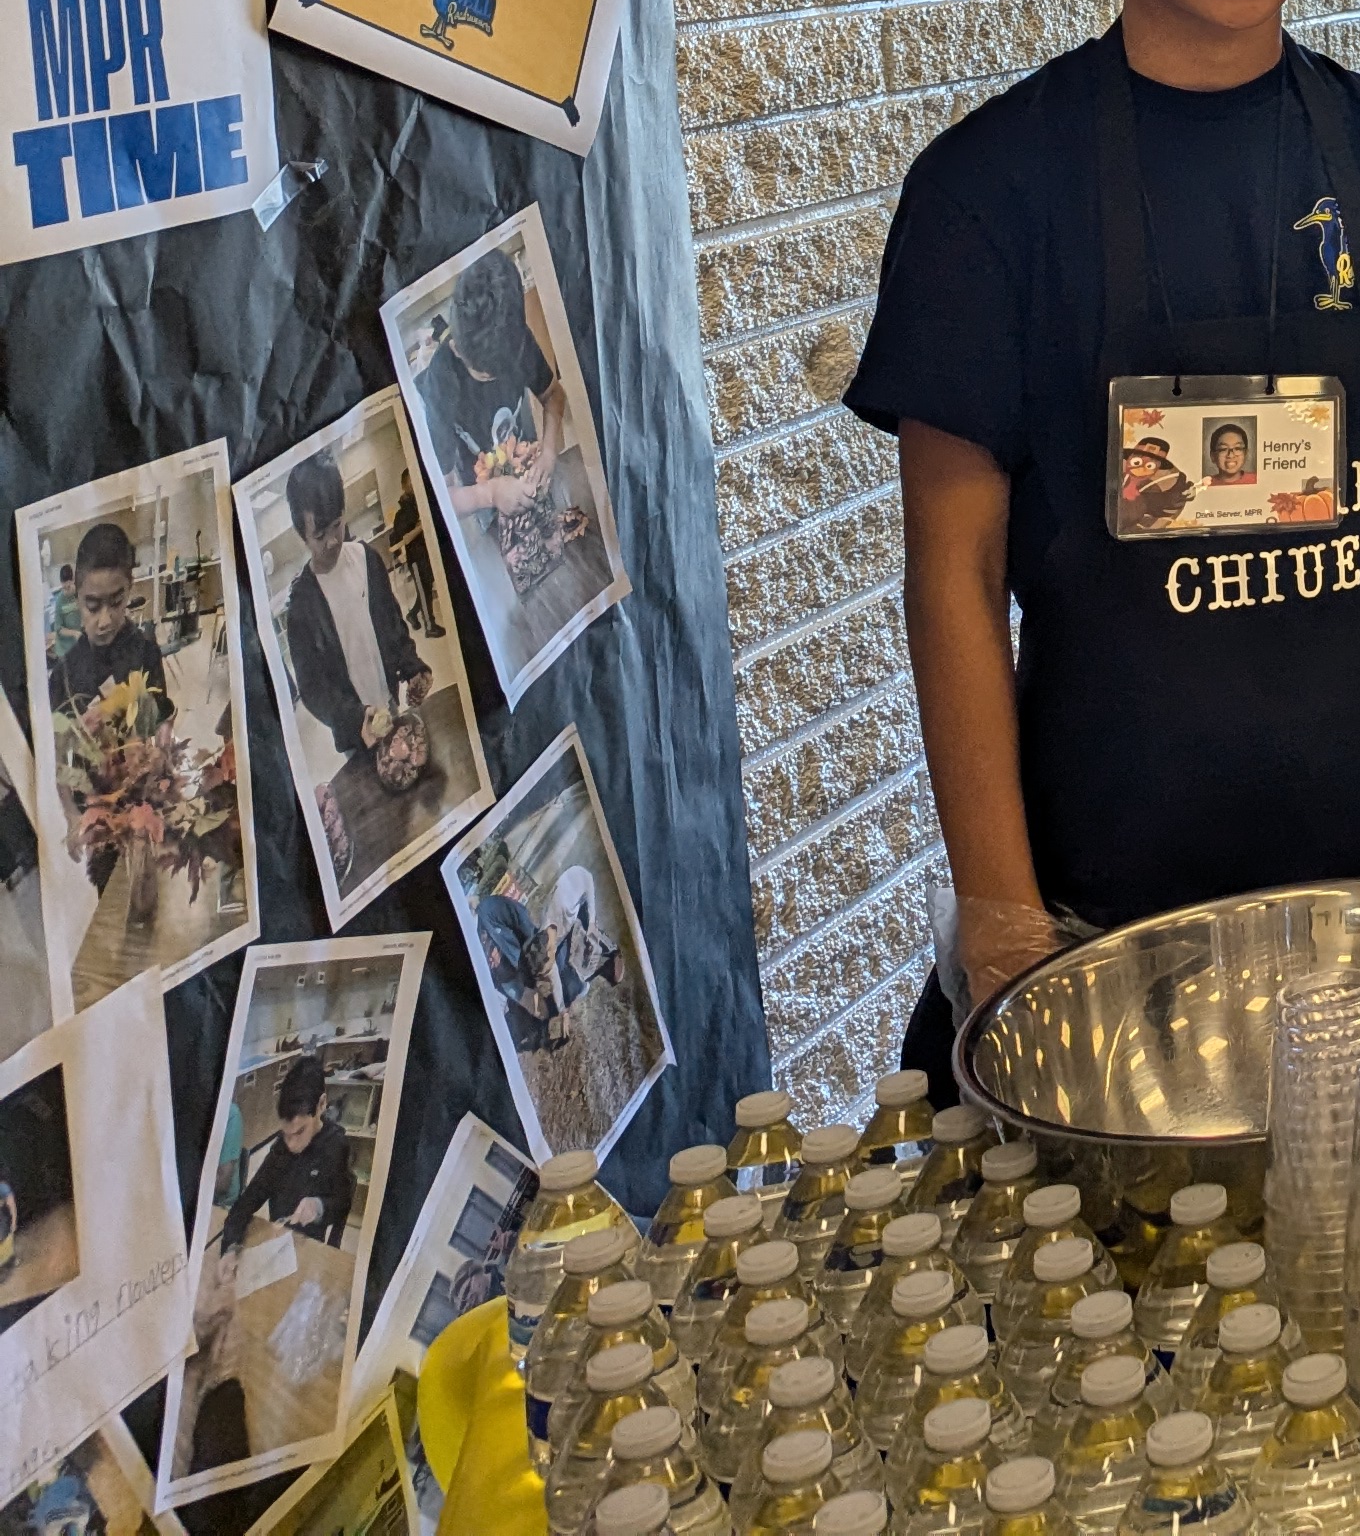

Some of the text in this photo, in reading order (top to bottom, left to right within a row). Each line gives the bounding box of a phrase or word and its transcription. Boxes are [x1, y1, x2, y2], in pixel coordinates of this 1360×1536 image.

[12, 94, 249, 229] TIME
[1262, 438, 1312, 454] Henry's
[1262, 457, 1307, 471] Friend
[1216, 510, 1243, 518] Server,
[1244, 508, 1263, 516] MPR
